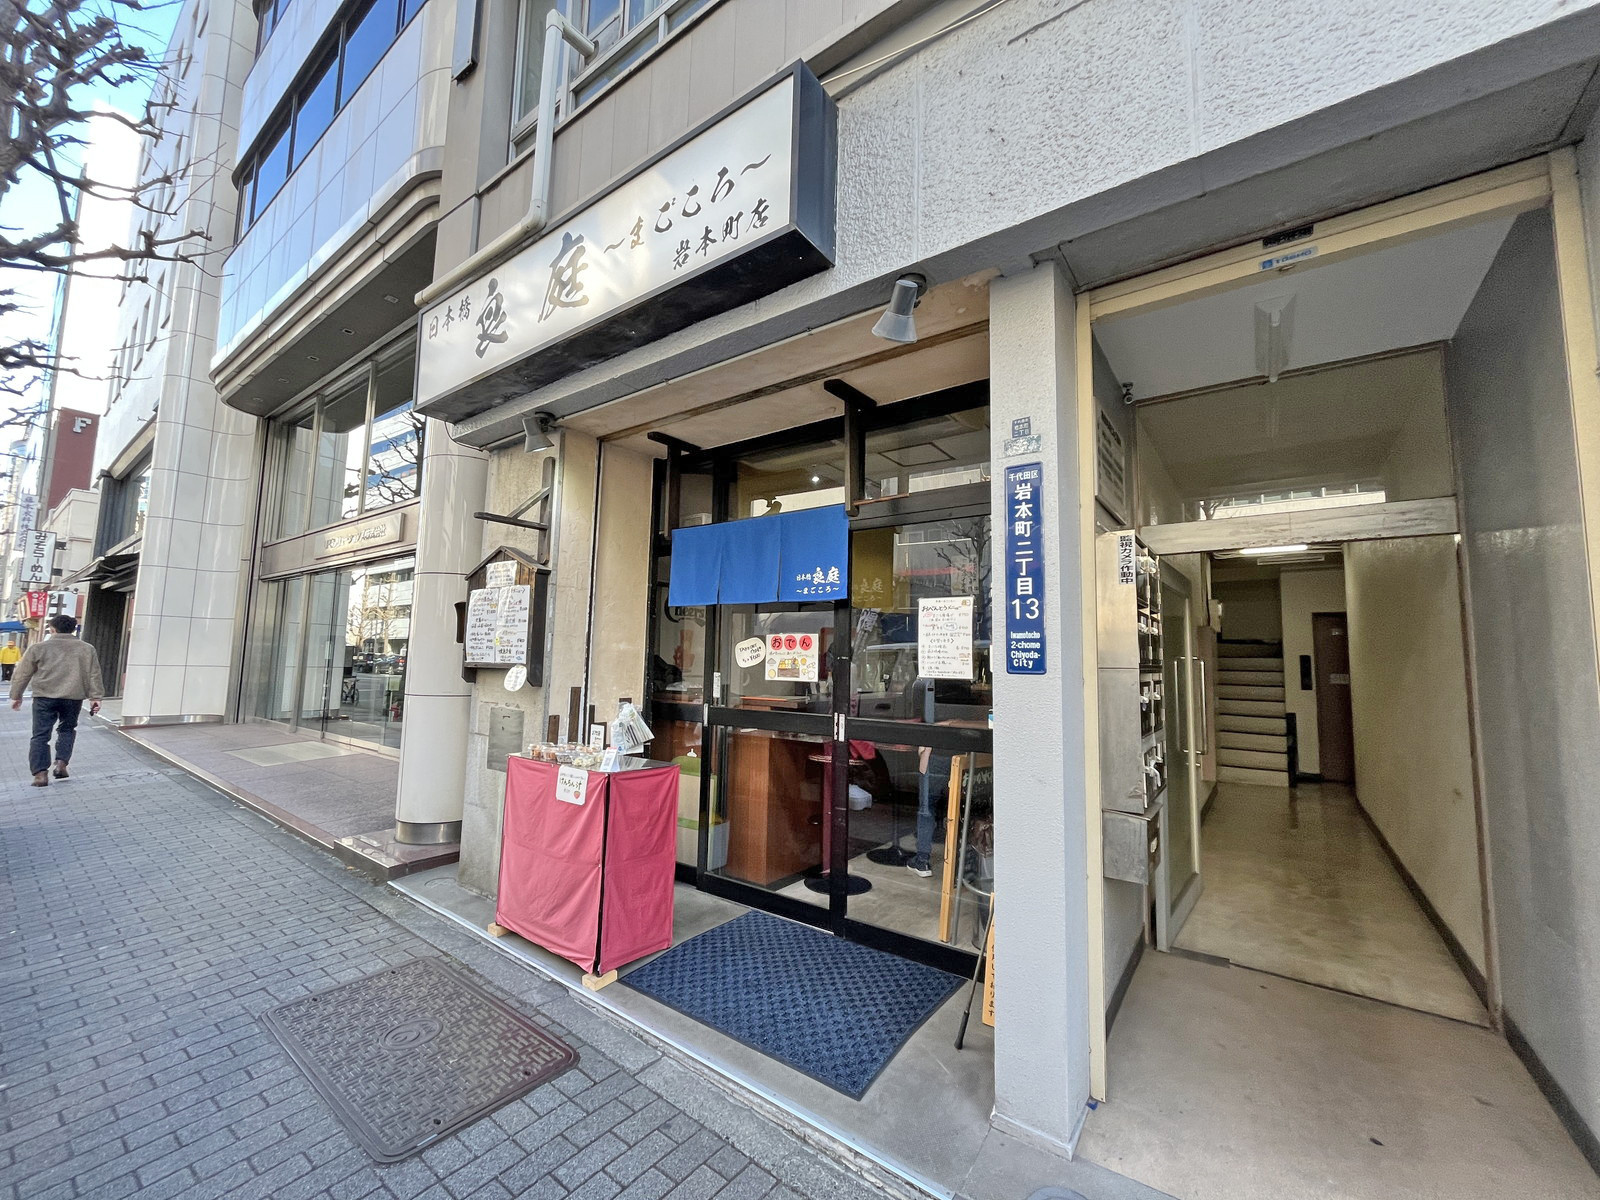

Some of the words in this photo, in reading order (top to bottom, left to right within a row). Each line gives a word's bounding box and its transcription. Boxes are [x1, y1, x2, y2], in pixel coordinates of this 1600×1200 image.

[673, 197, 769, 271] 岩本町店
[428, 297, 471, 340] 日本橋
[73, 416, 91, 433] F
[1008, 469, 1038, 482] 千代田区
[1119, 534, 1134, 584] 監視カメラ作動中
[812, 565, 841, 585] 良庭
[1011, 597, 1040, 621] 13
[771, 637, 811, 649] おでん
[1010, 630, 1041, 640] Iwamotocho
[1010, 641, 1041, 650] 2-chome
[1013, 658, 1034, 669] City
